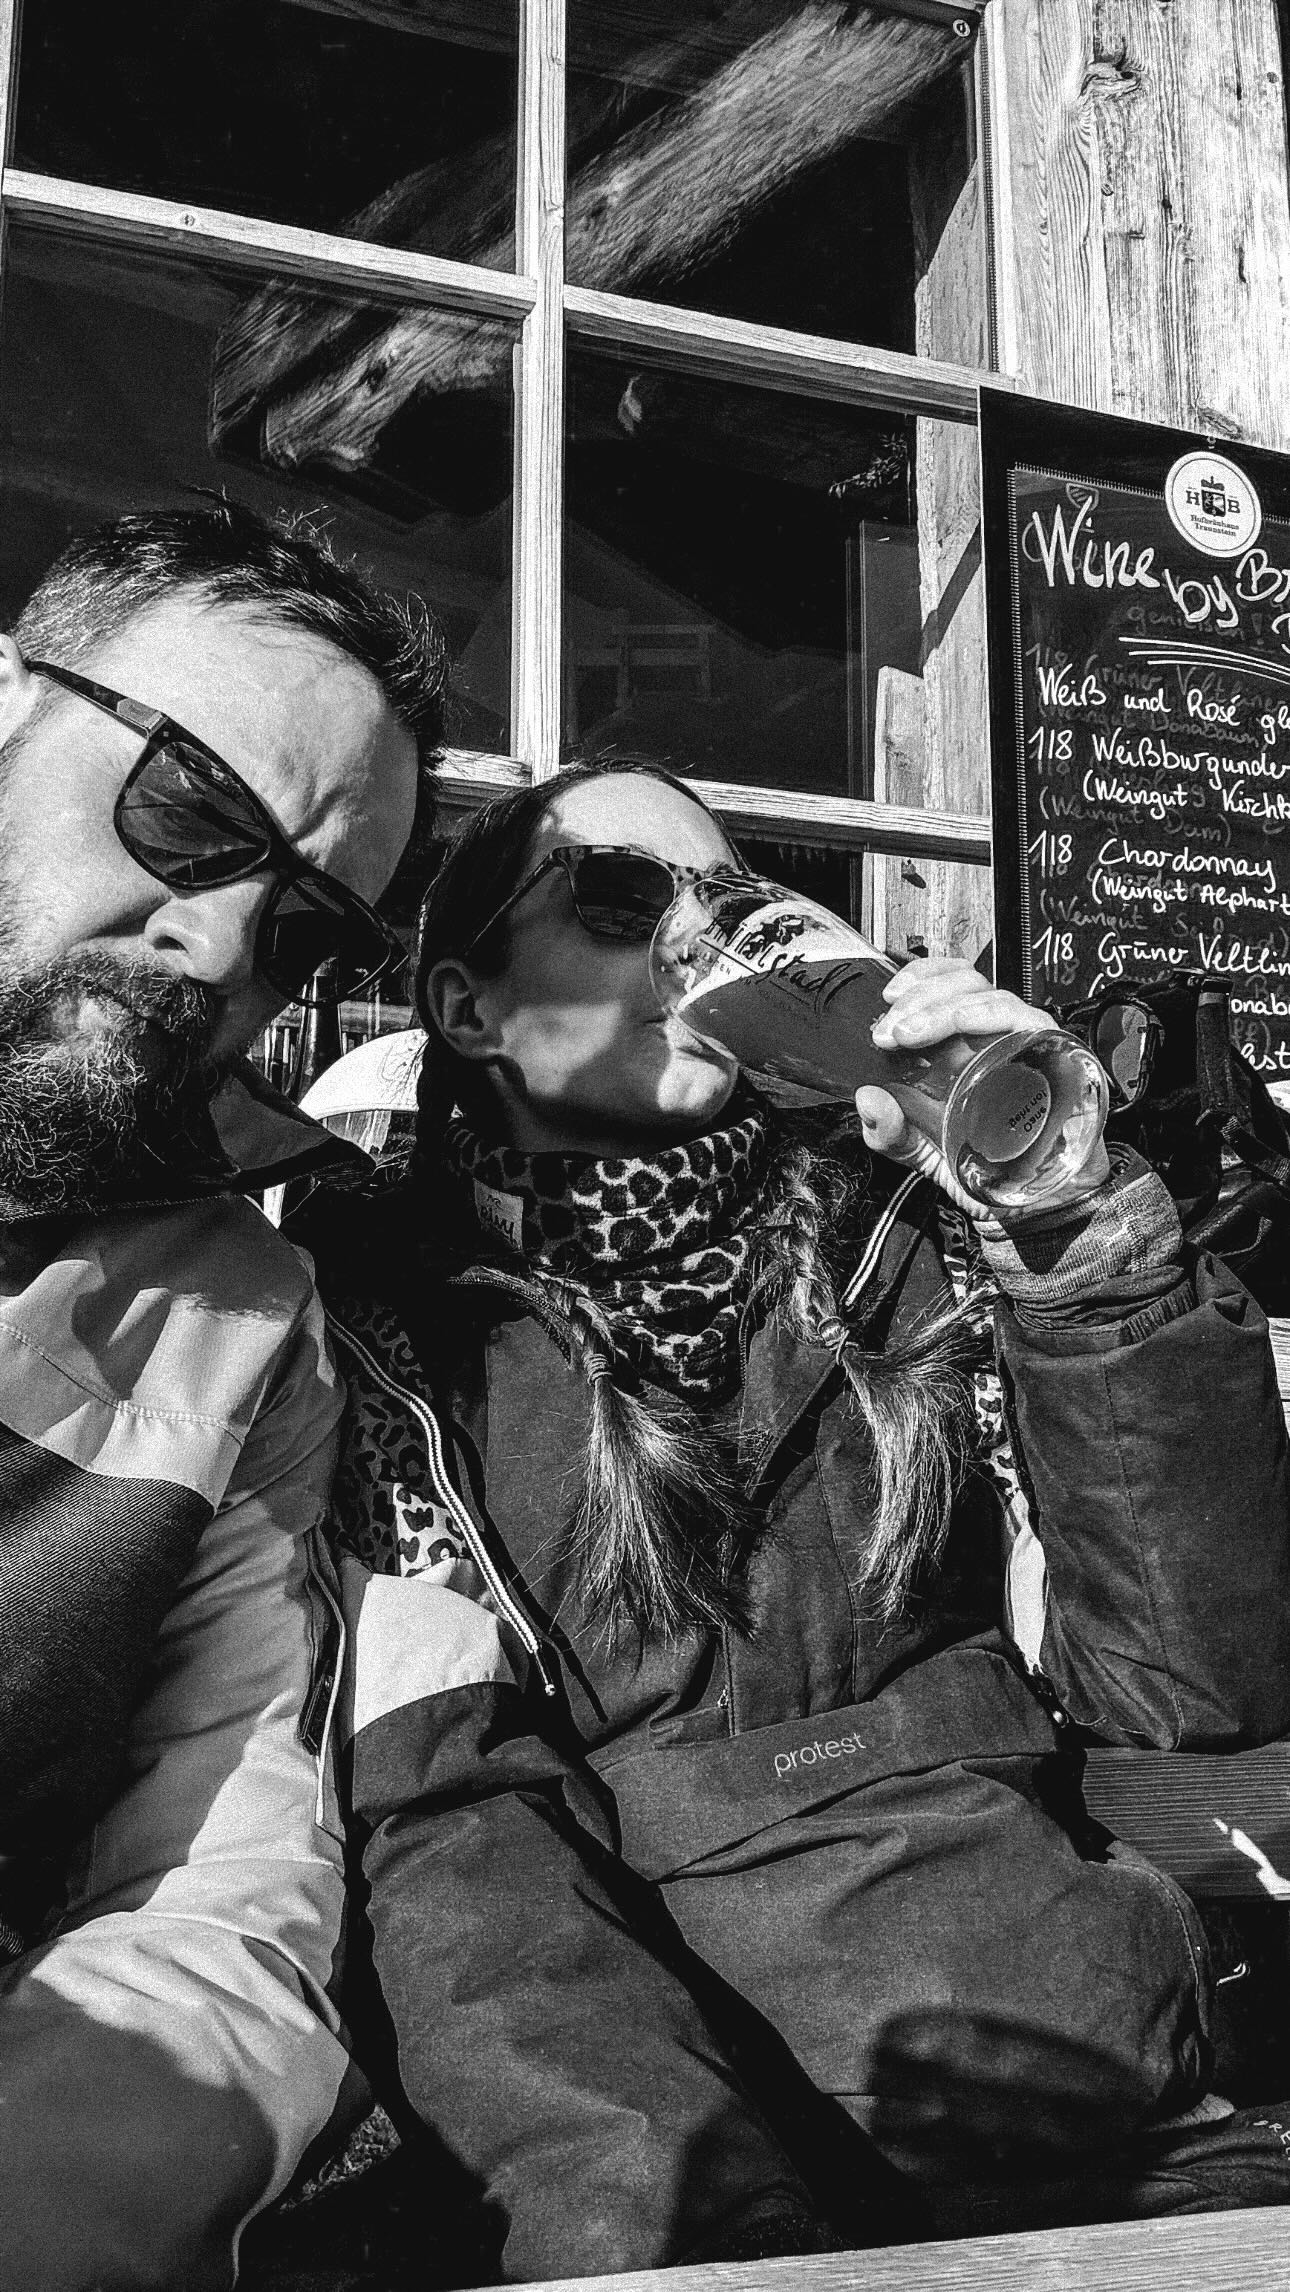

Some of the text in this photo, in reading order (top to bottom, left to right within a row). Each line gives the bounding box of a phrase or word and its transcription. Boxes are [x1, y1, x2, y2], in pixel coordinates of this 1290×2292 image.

[1186, 490, 1240, 513] H B
[1031, 496, 1161, 588] Wine
[1164, 569, 1238, 628] by
[1235, 548, 1290, 602] B
[1038, 664, 1107, 707] Weiß
[1124, 688, 1171, 713] und
[1187, 689, 1241, 726] Rosé
[1098, 838, 1276, 894] Chardonnay
[1098, 932, 1188, 978] Grüner
[774, 1732, 867, 1778] protest
